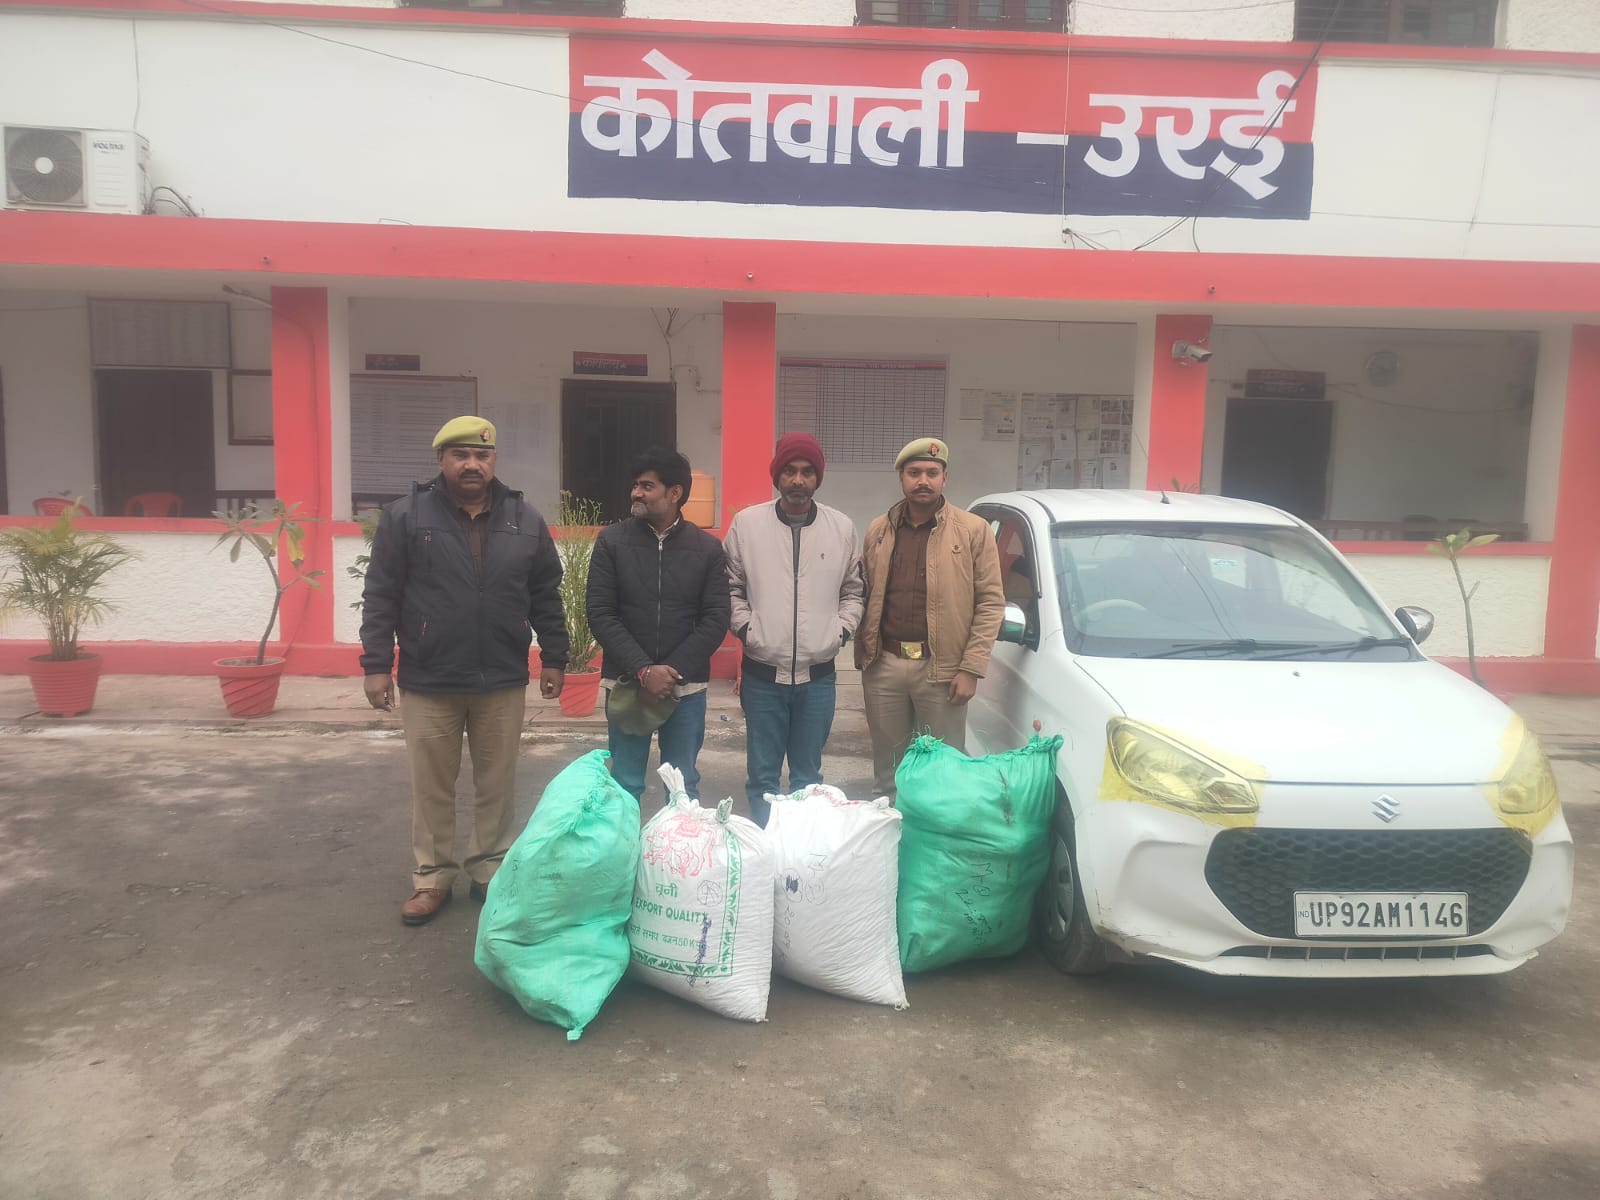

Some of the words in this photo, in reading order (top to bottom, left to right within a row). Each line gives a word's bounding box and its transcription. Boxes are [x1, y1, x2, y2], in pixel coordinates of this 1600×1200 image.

[579, 47, 980, 169] कोतवाली
[1083, 68, 1297, 201] उरई
[635, 897, 664, 916] EXPORT
[665, 906, 710, 923] QUALITY
[1309, 901, 1464, 928] UP92AM1146
